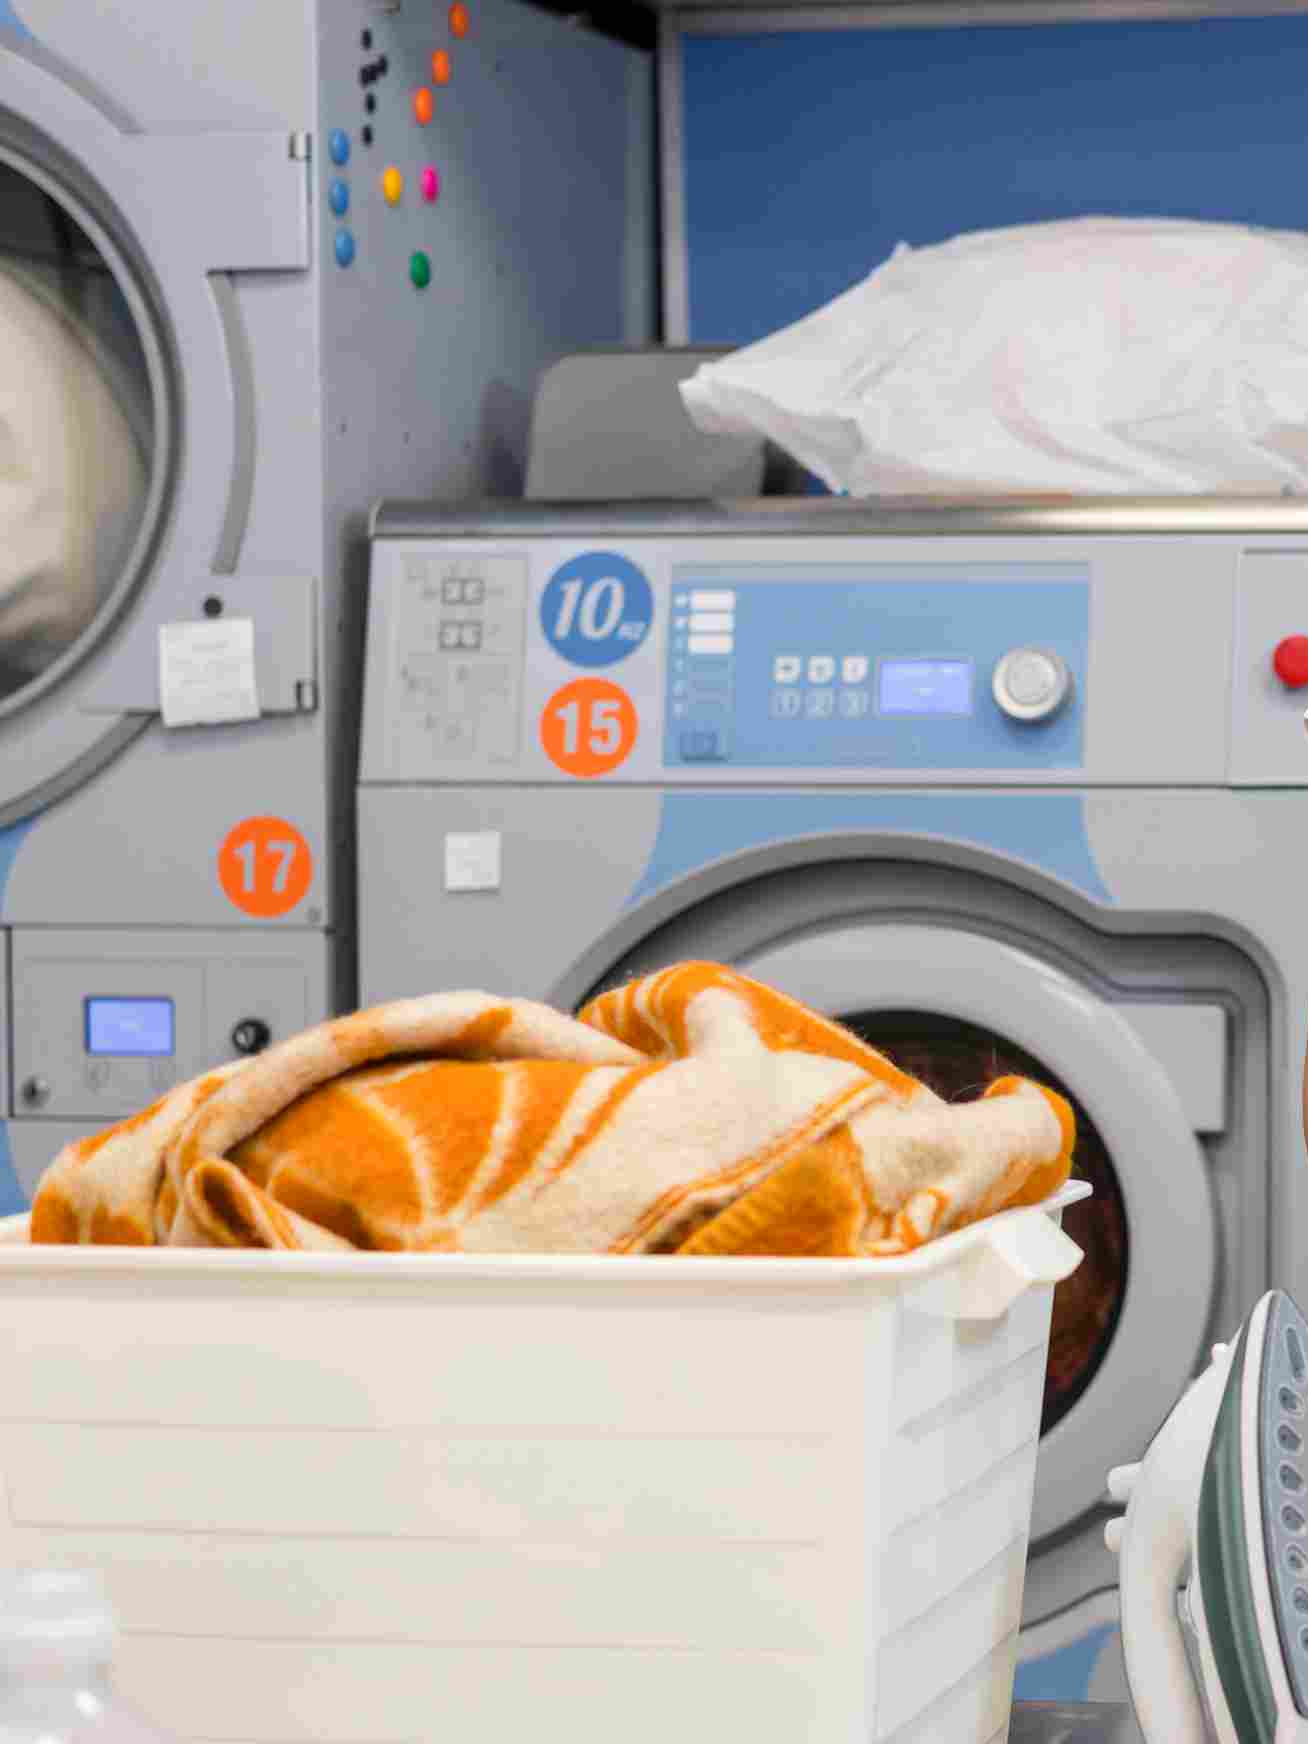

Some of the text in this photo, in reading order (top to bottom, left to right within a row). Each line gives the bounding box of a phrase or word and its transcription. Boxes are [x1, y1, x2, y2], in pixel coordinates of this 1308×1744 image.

[553, 576, 625, 640] 10
[555, 701, 621, 754] 15
[233, 841, 295, 892] 17
